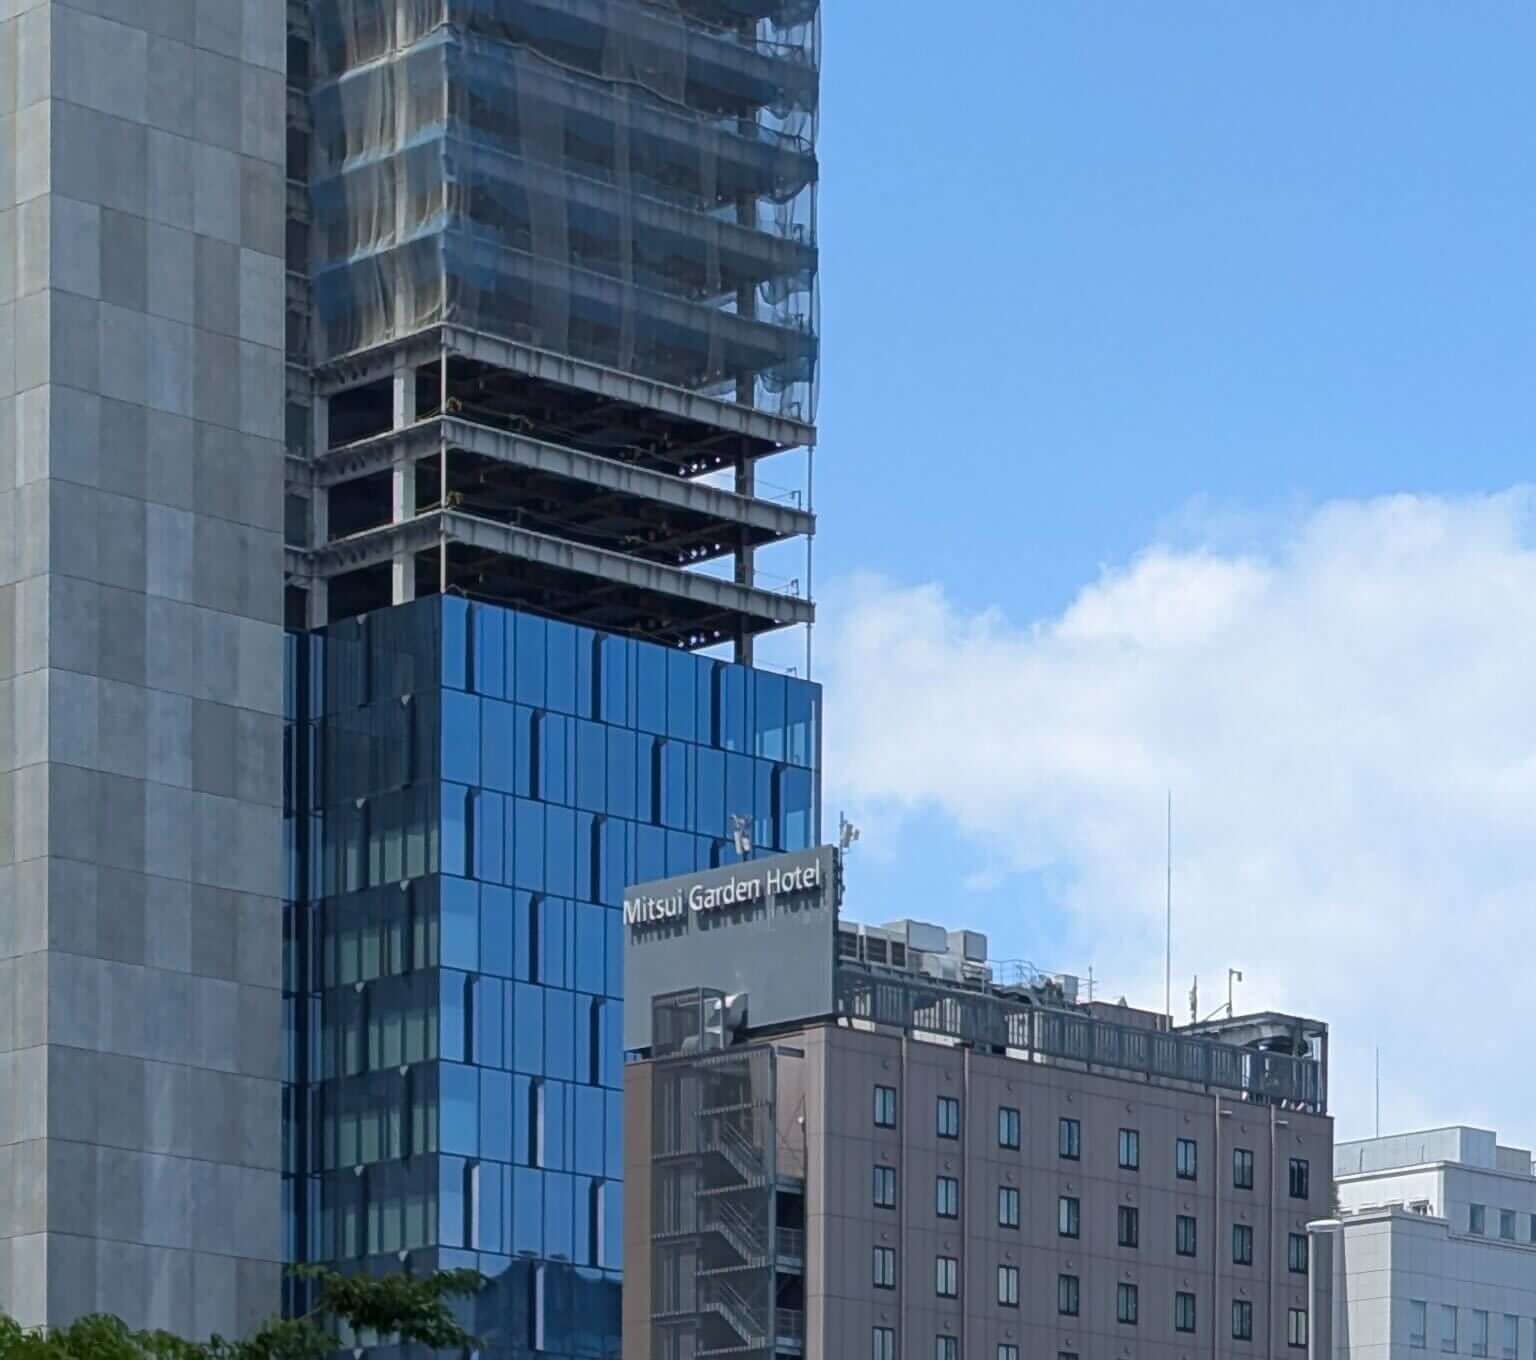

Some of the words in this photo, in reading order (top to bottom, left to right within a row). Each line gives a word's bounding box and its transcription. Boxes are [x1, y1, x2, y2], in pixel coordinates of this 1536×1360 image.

[623, 889, 683, 925] Mitsui
[689, 877, 760, 911] Garden
[766, 859, 820, 895] Hotel
